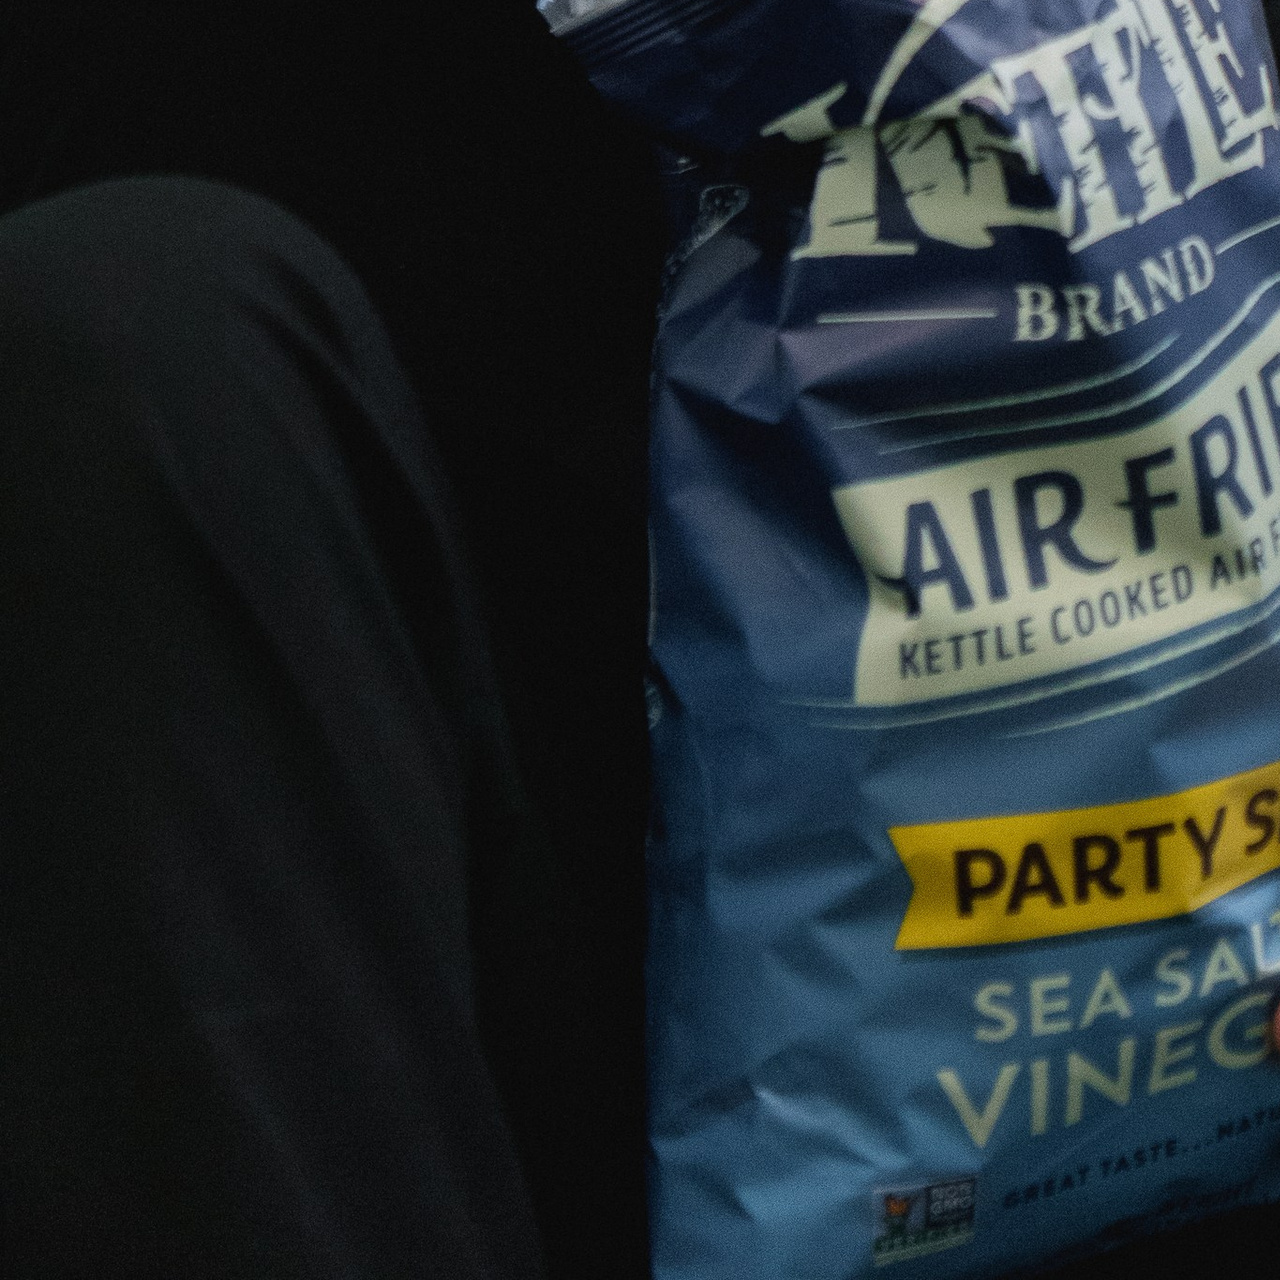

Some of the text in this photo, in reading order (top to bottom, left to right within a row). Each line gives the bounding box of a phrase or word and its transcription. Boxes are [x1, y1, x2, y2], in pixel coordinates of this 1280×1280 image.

[1014, 235, 1216, 343] BRAND
[900, 468, 1120, 621] AIR
[900, 616, 1035, 680] KETTLE
[1050, 566, 1196, 644] COOKED
[1208, 537, 1267, 594] AIR
[952, 806, 1228, 920] PARTY
[973, 969, 1133, 1044] SEA
[936, 990, 1274, 1150] VINEG
[930, 1195, 973, 1216] GMO
[1002, 1166, 1093, 1209] GREAT
